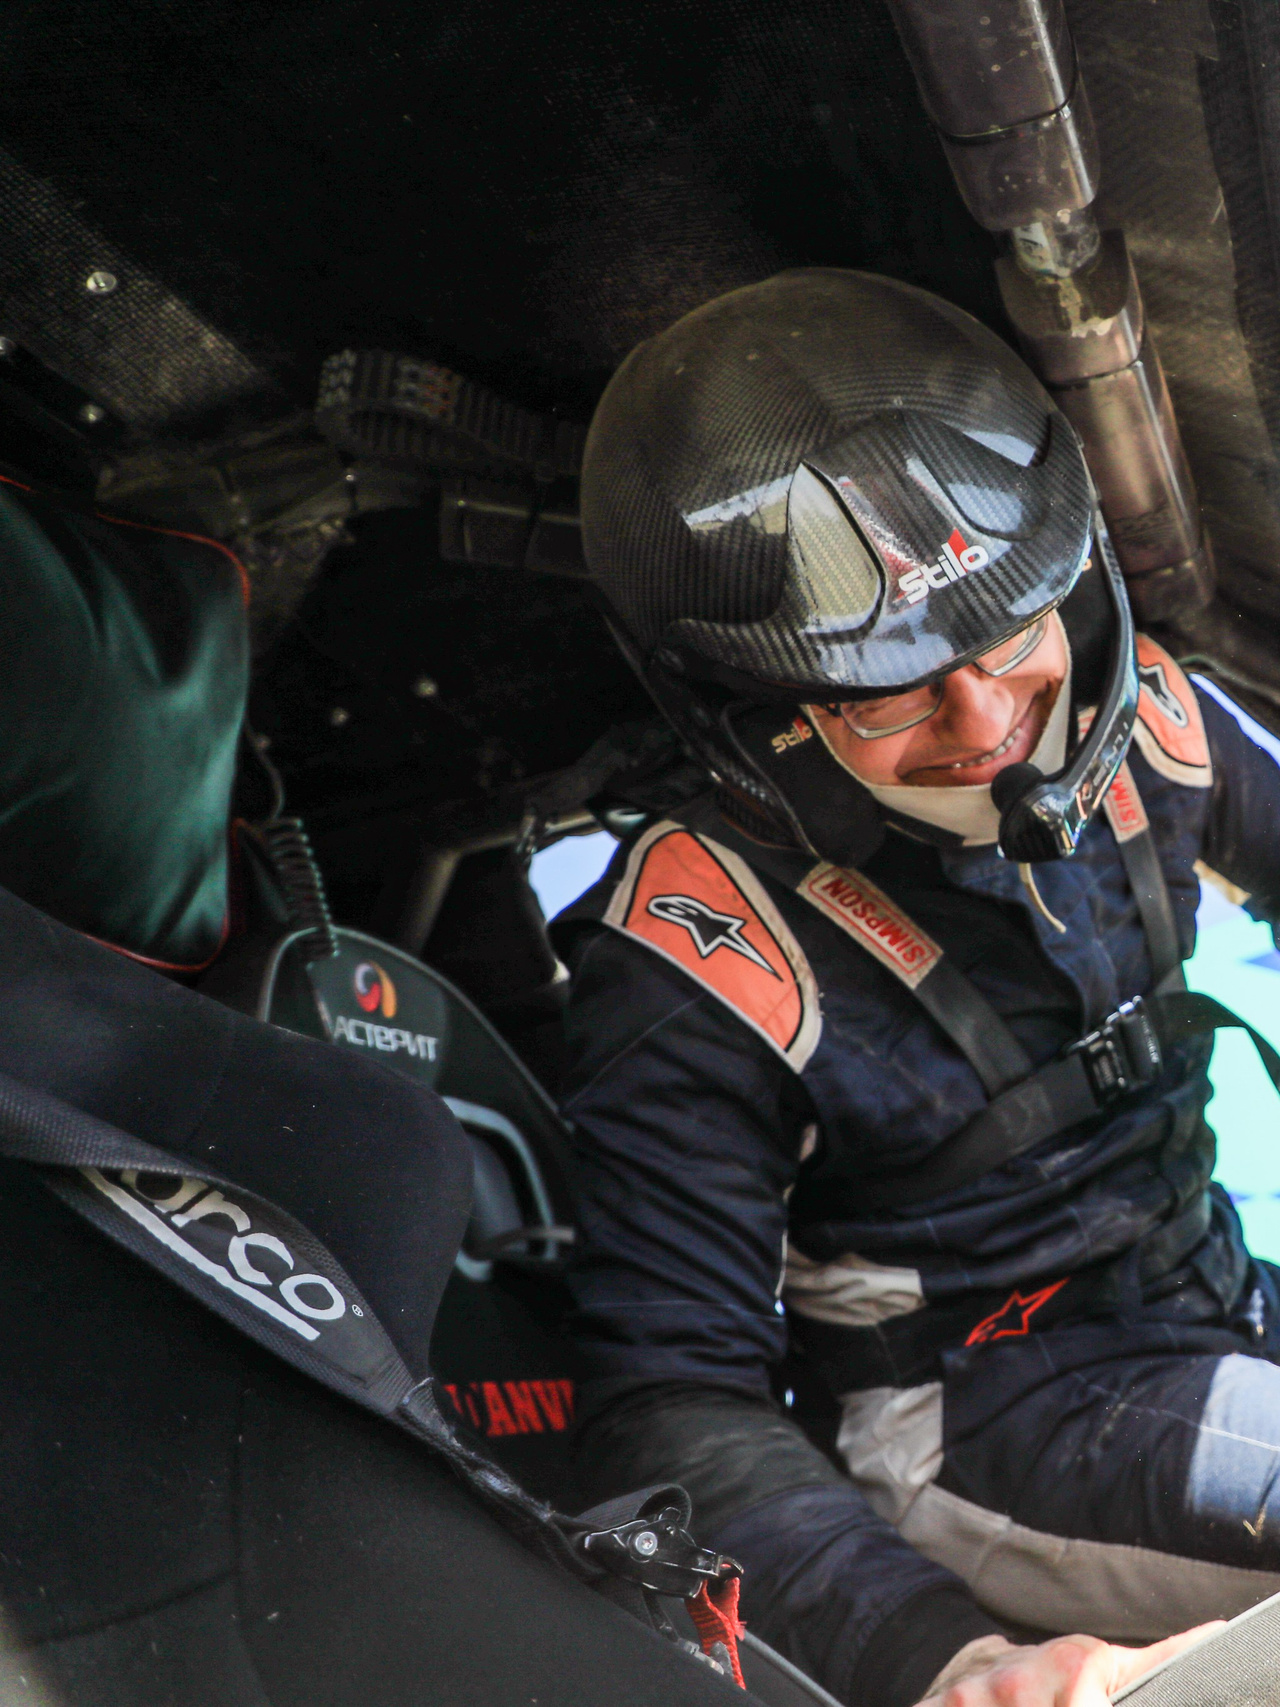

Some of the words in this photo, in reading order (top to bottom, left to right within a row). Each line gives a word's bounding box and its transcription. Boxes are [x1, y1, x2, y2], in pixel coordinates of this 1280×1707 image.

[821, 877, 926, 964] SIMPSON
[333, 1014, 438, 1063] АСТЕРИТ
[119, 1168, 347, 1322] arco
